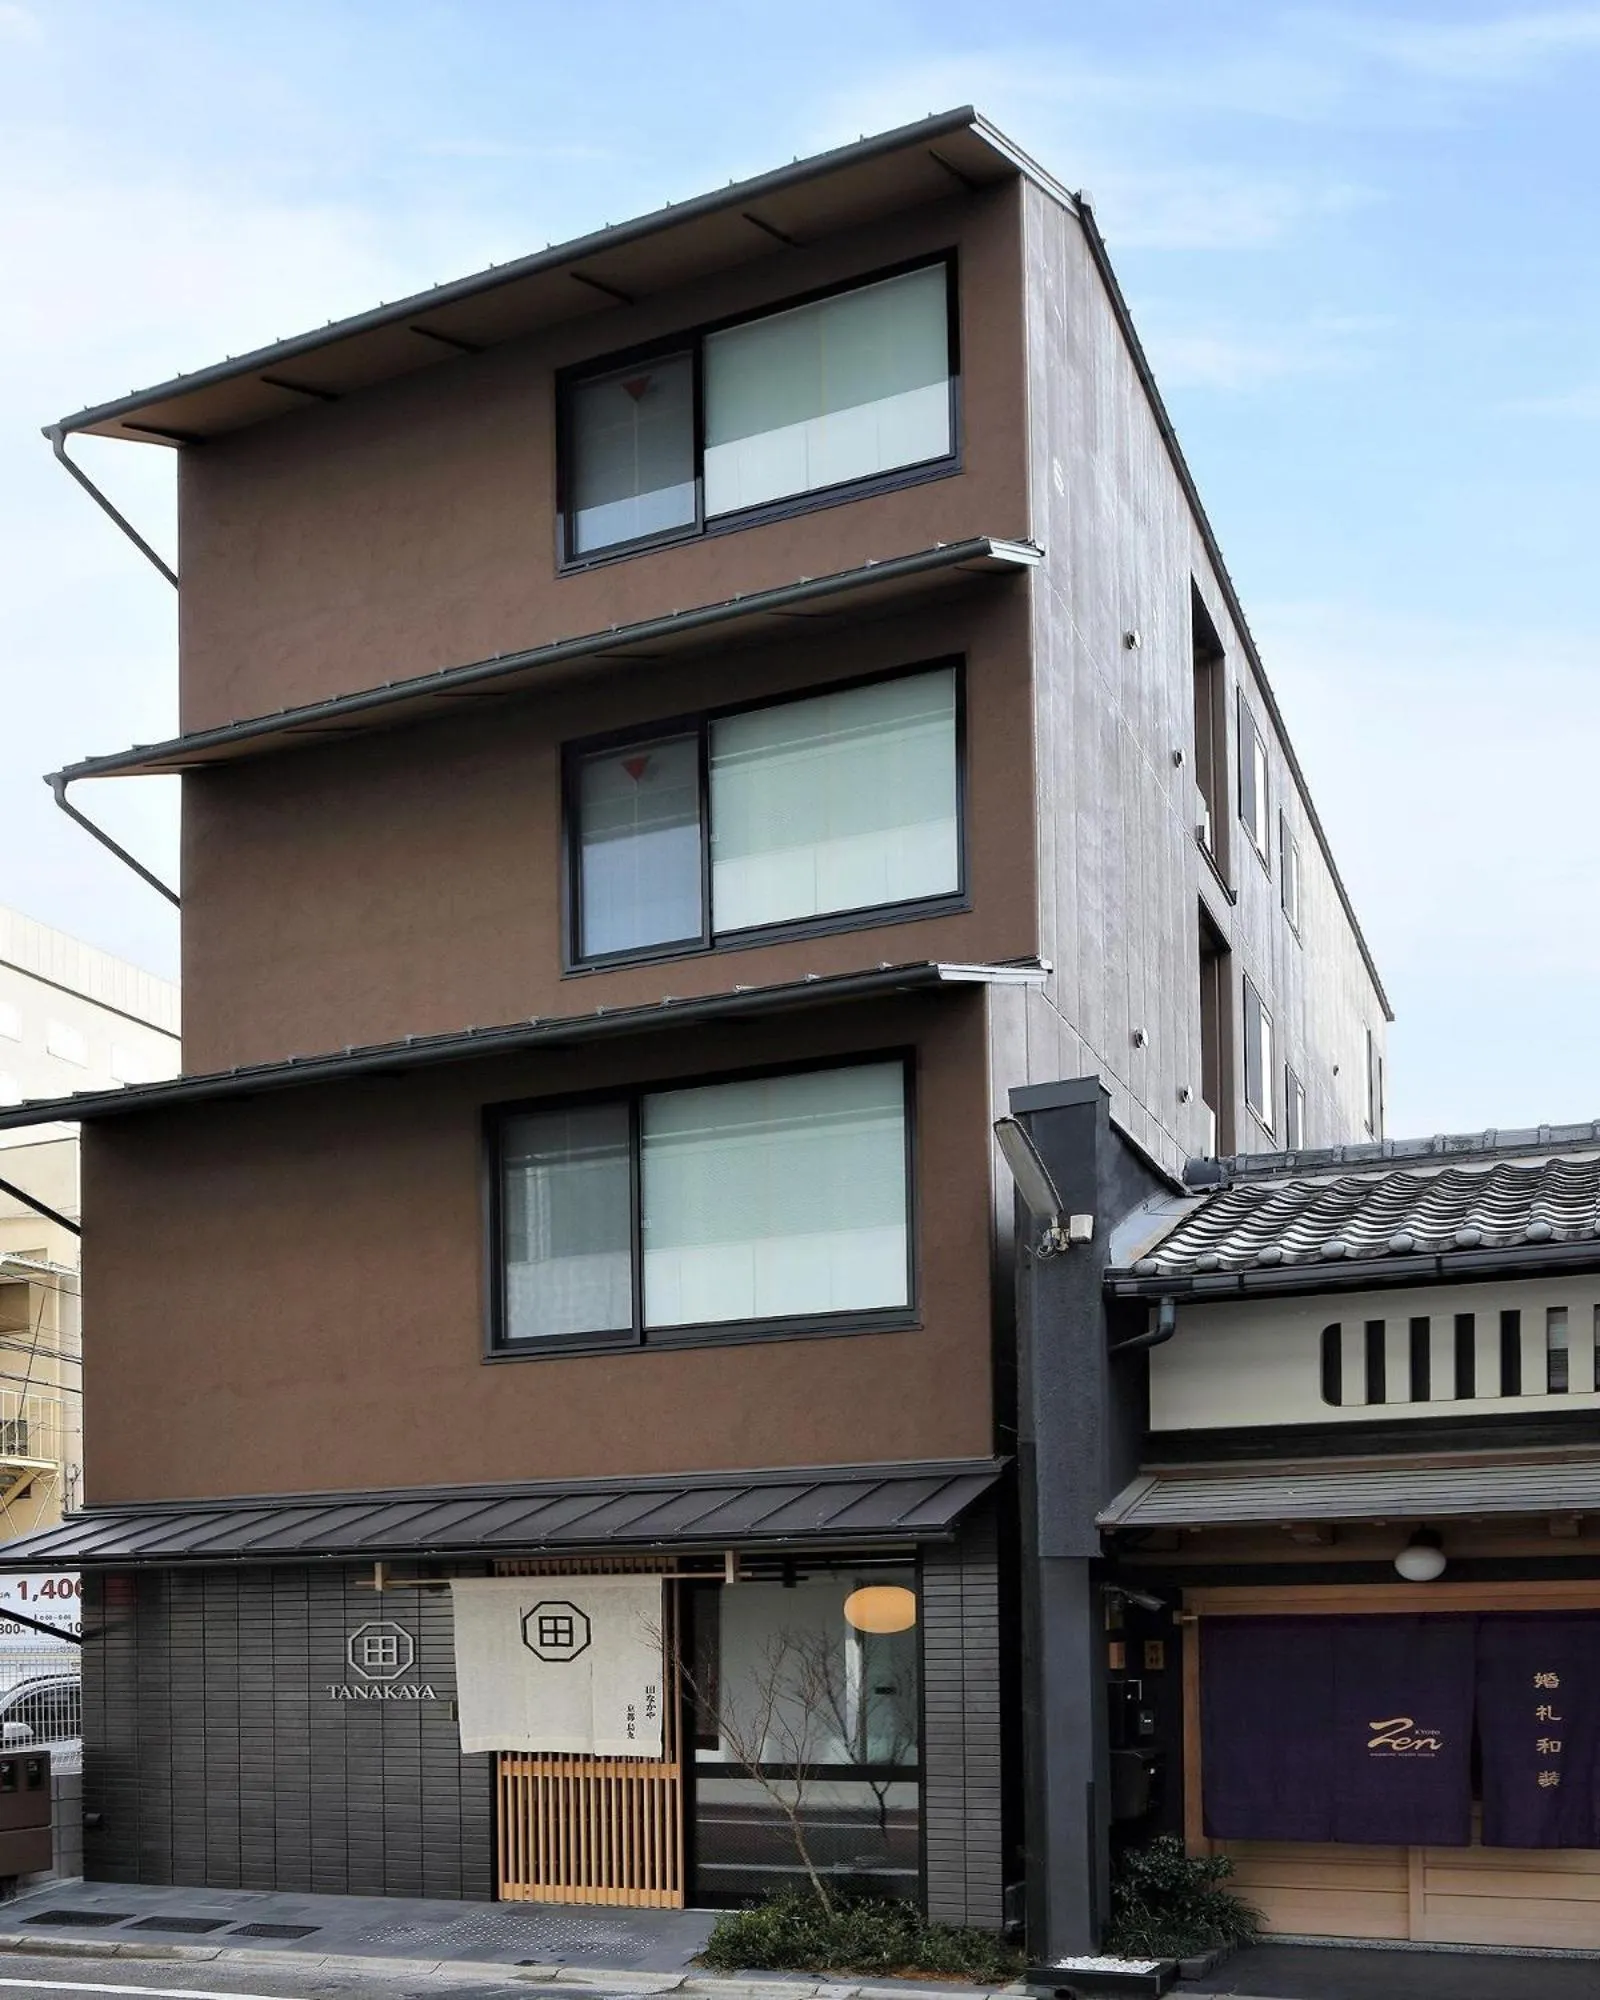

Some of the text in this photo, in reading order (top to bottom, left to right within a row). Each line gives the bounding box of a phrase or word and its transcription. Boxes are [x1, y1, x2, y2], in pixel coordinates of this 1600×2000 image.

[326, 1684, 437, 1700] TANAKAYA
[1367, 1717, 1443, 1751] Zen
[1533, 1672, 1562, 1788] 婚礼和装
